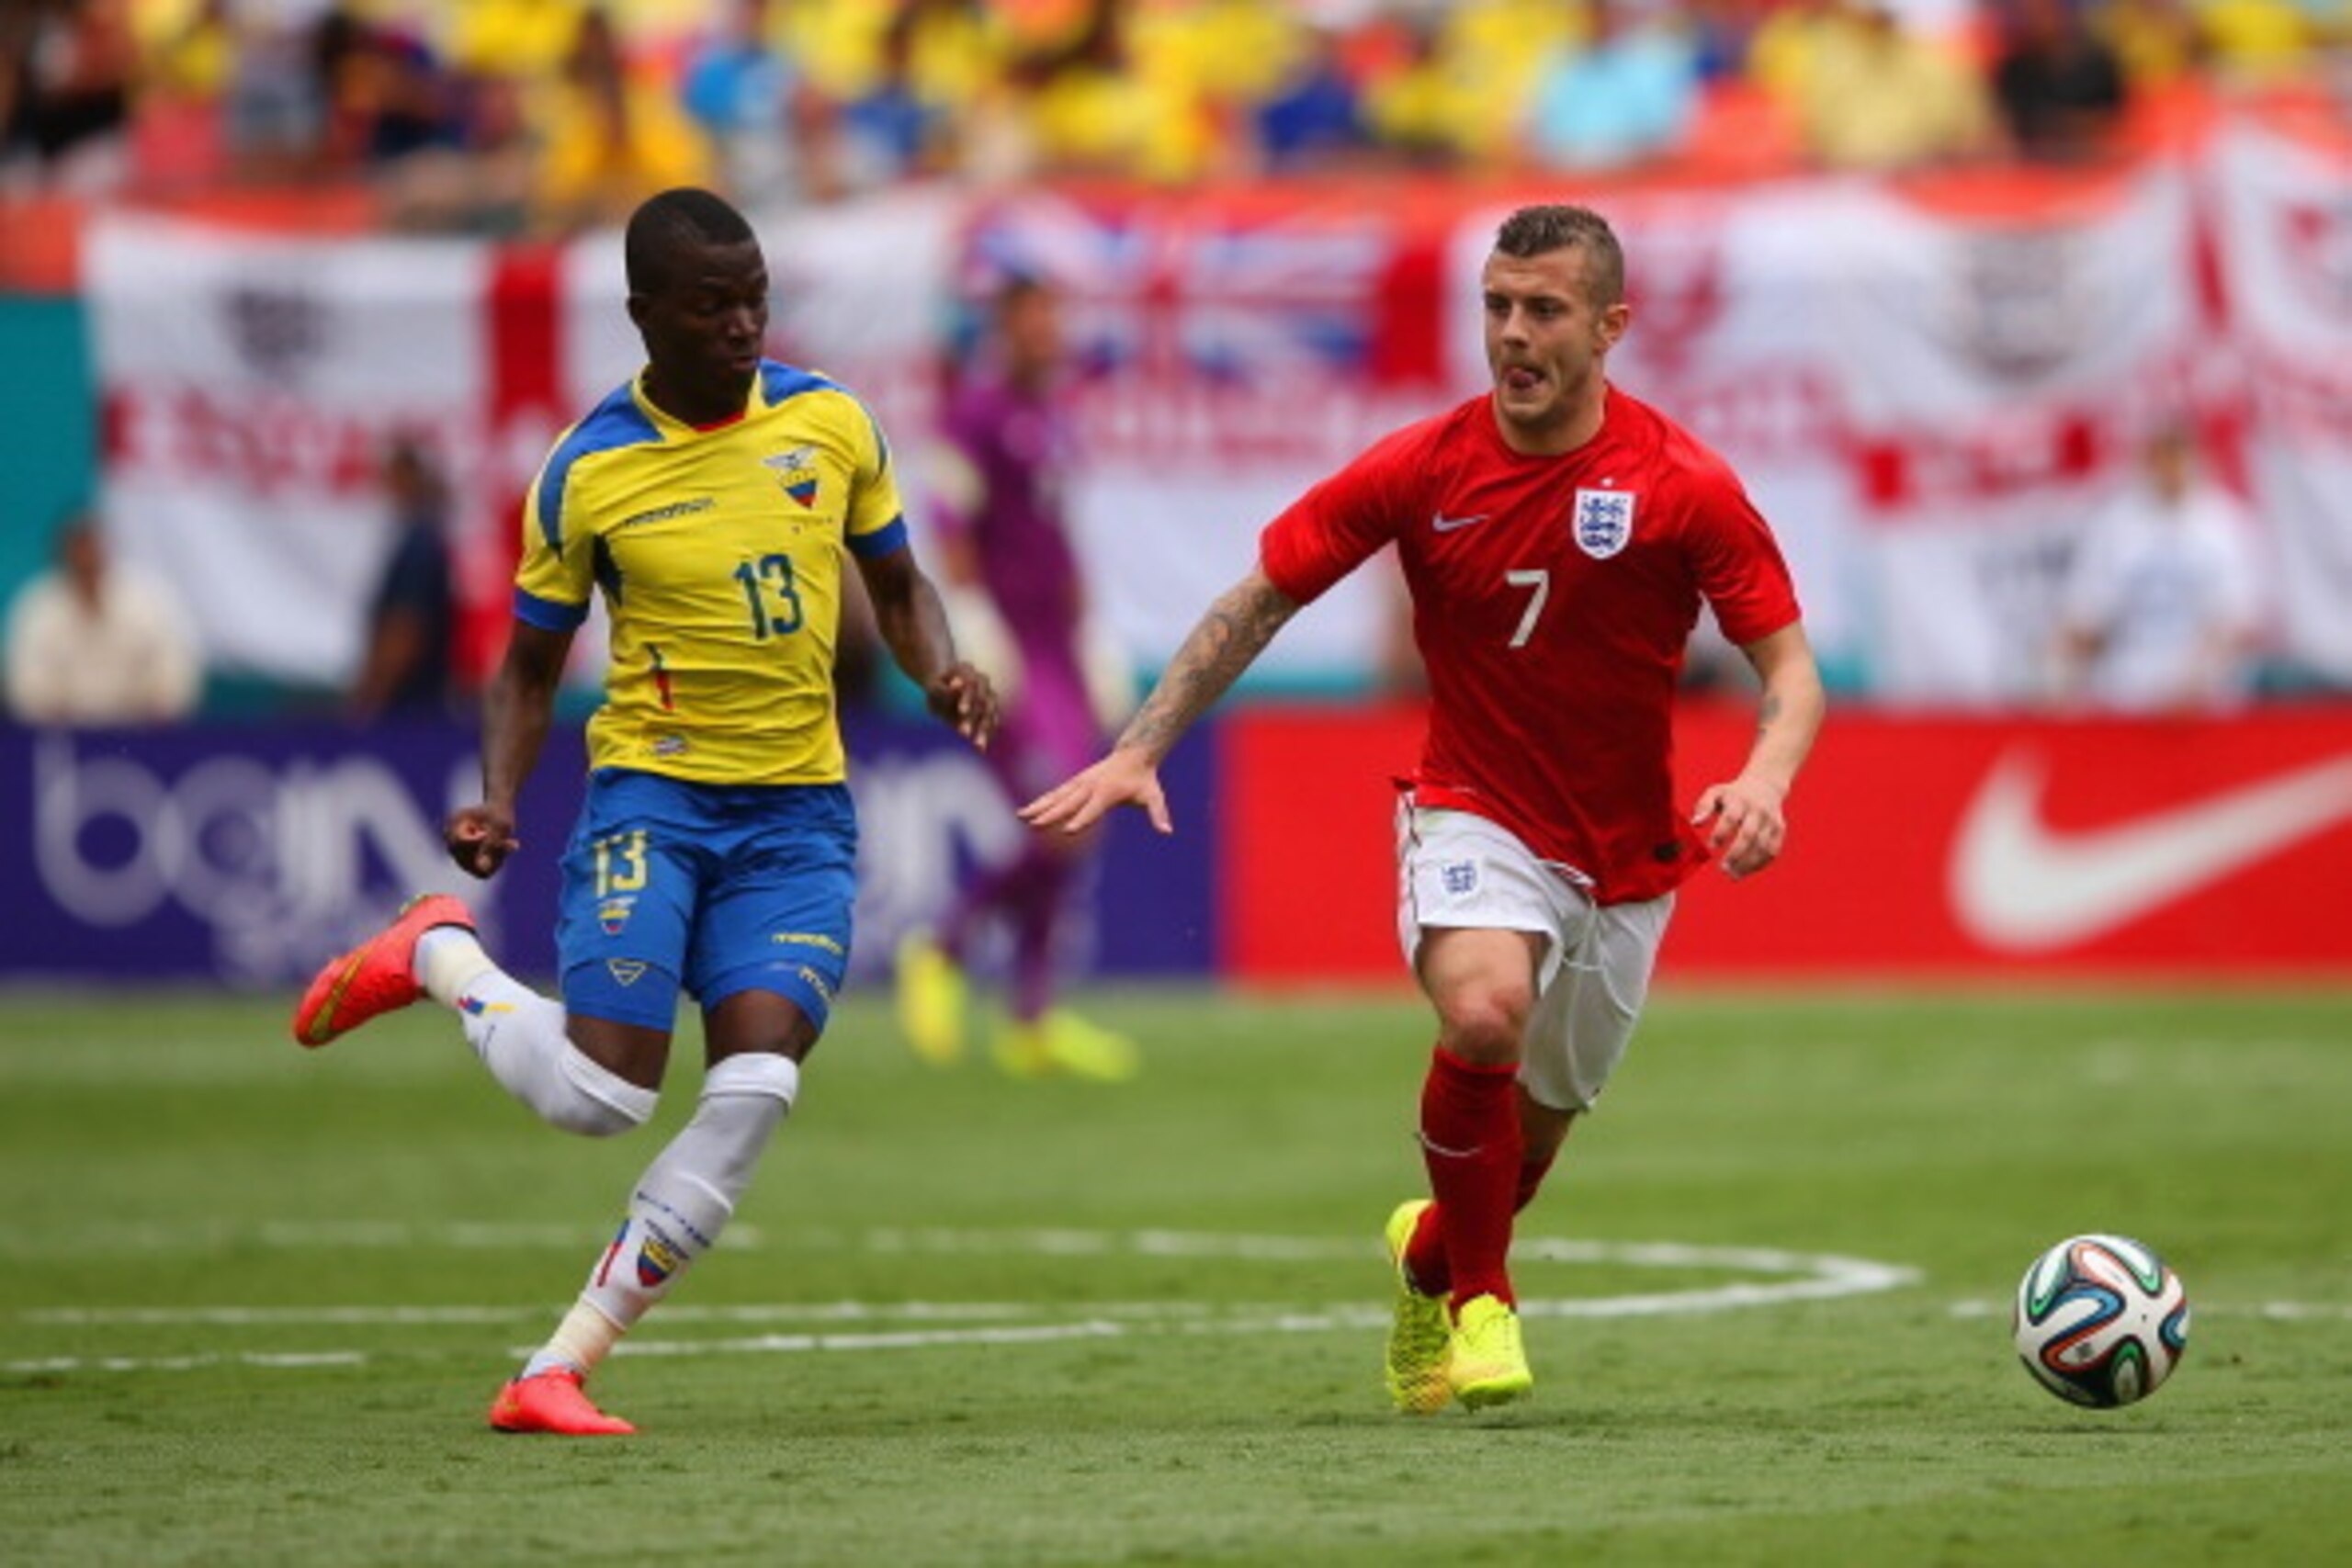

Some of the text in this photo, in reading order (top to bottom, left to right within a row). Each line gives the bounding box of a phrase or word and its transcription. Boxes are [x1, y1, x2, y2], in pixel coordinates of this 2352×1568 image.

[733, 553, 802, 639] 13
[1505, 569, 1549, 648] 7
[594, 829, 647, 898] 13
